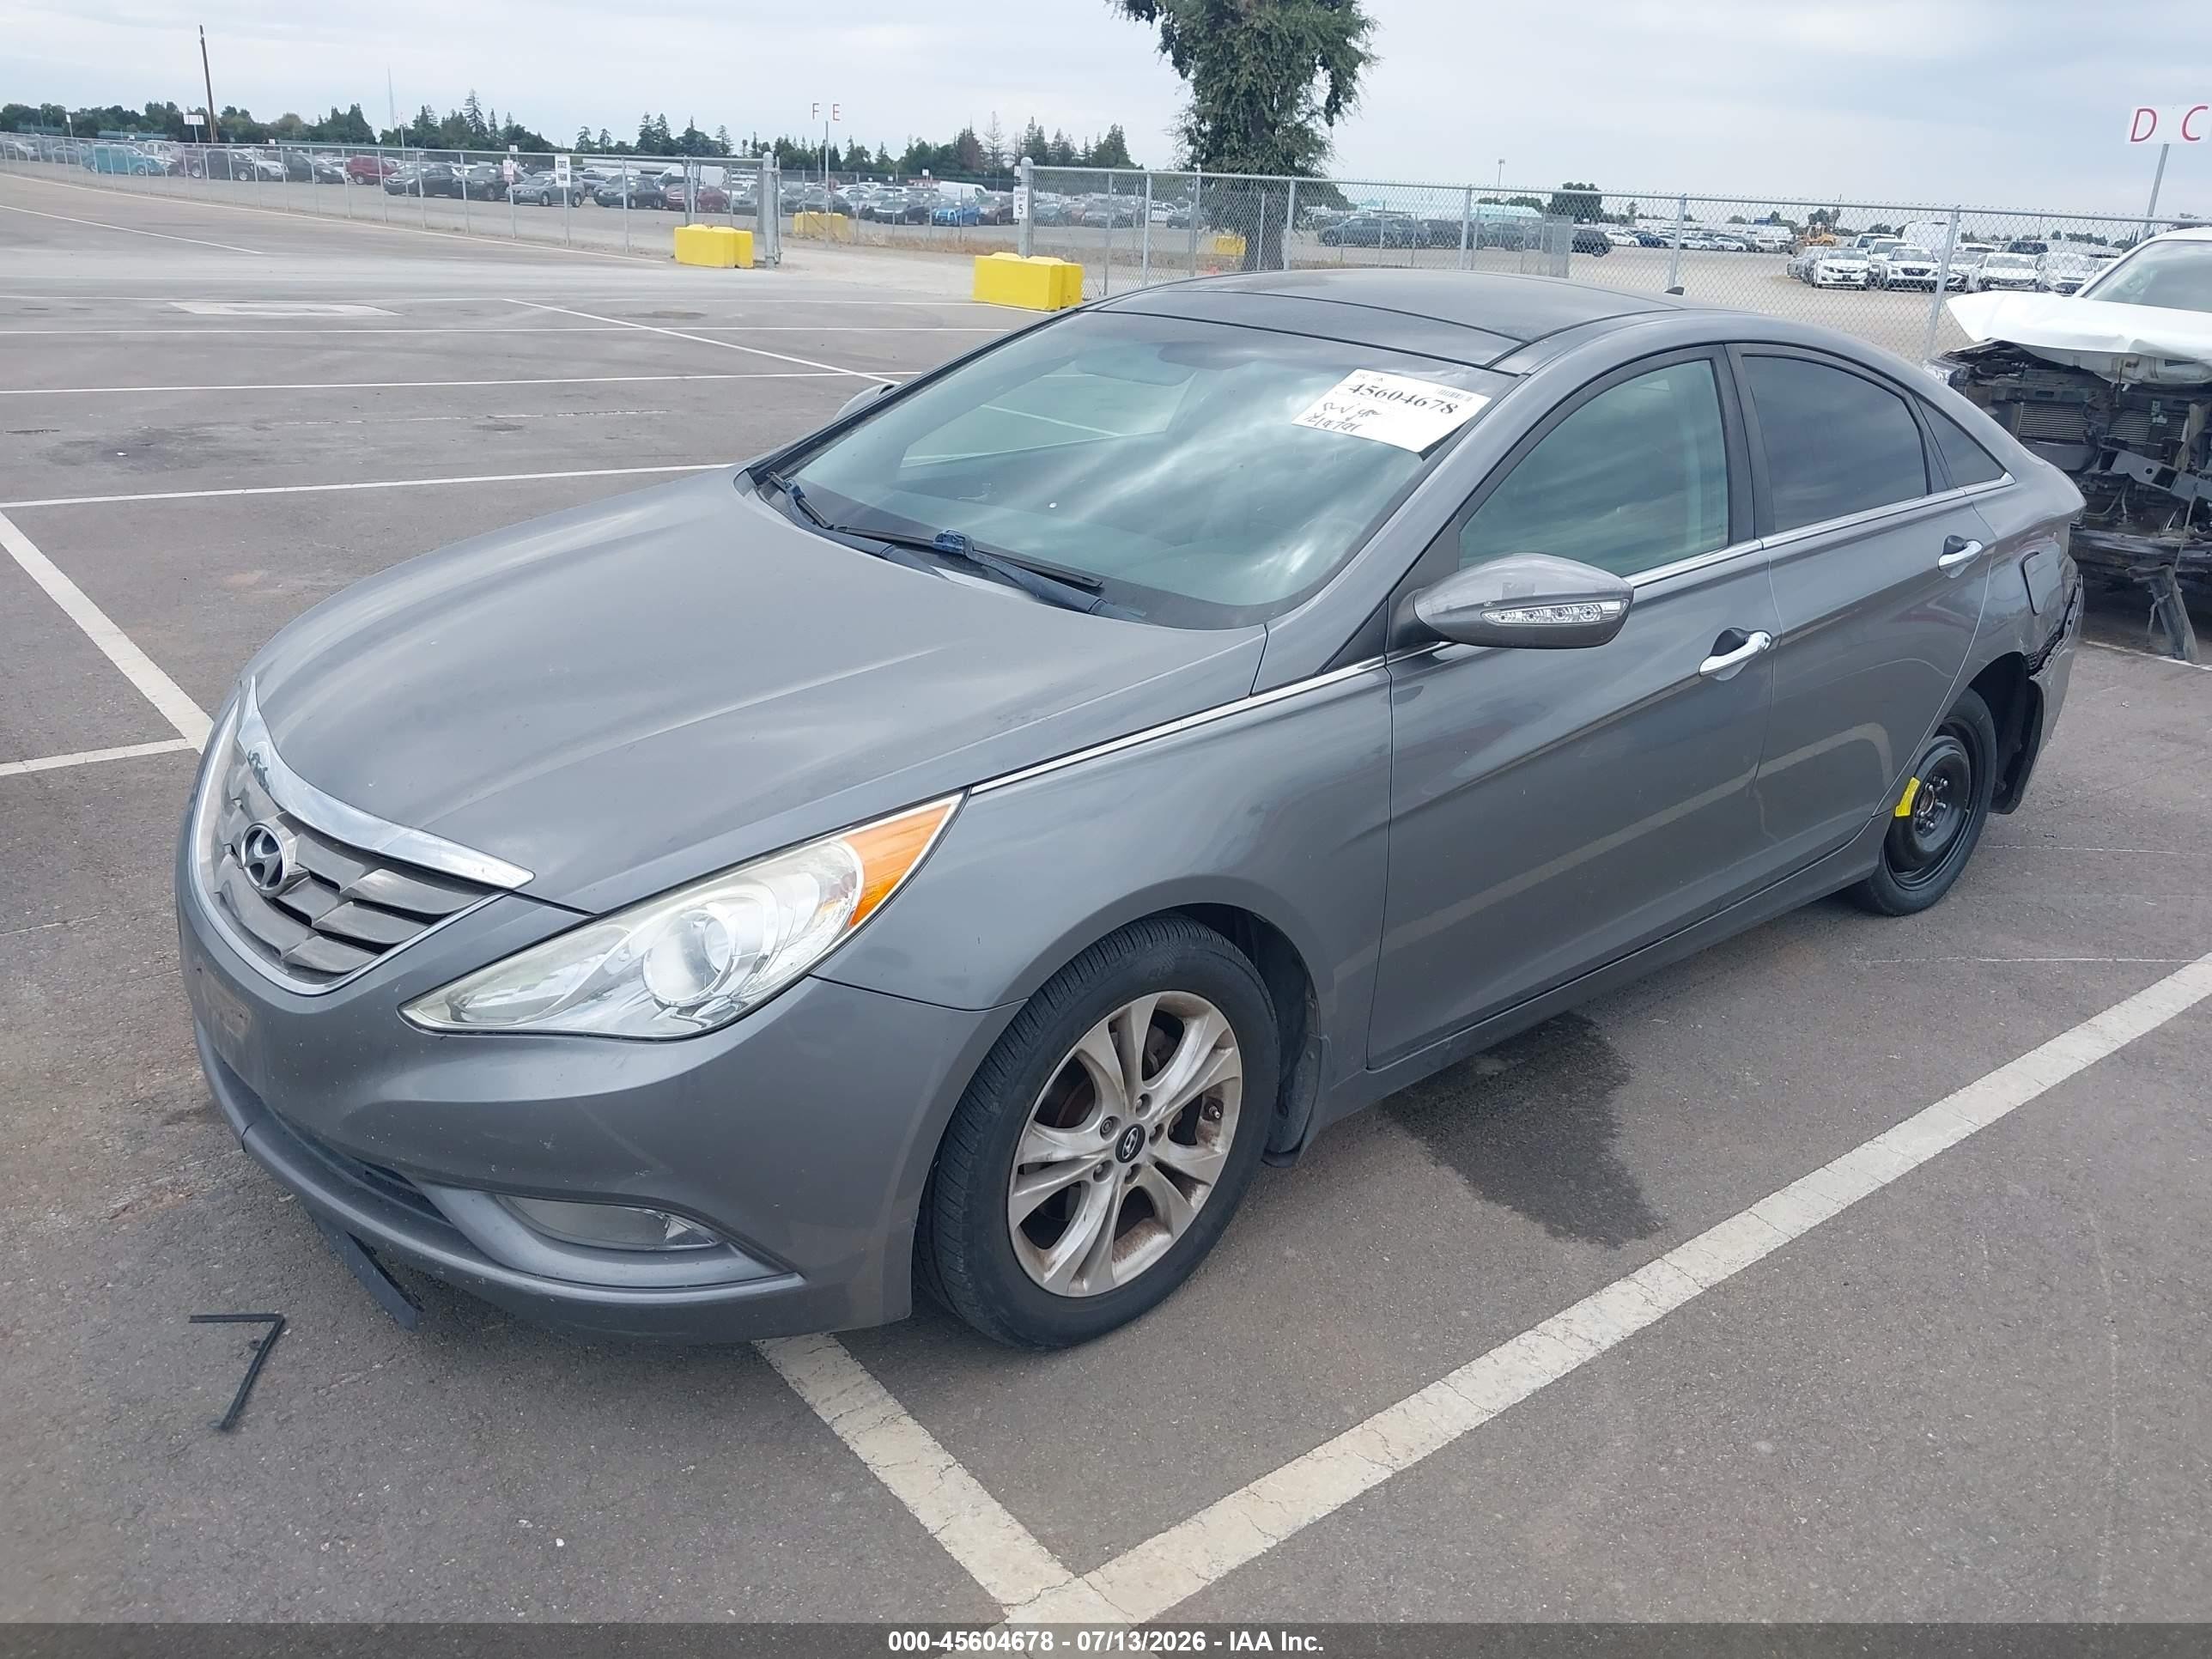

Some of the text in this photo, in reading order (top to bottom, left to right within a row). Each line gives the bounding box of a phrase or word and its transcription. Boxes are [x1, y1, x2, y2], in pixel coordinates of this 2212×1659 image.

[812, 102, 841, 121] F E
[2130, 105, 2209, 143] D C
[1018, 203, 1024, 215] 5
[1348, 383, 1458, 415] 45604678
